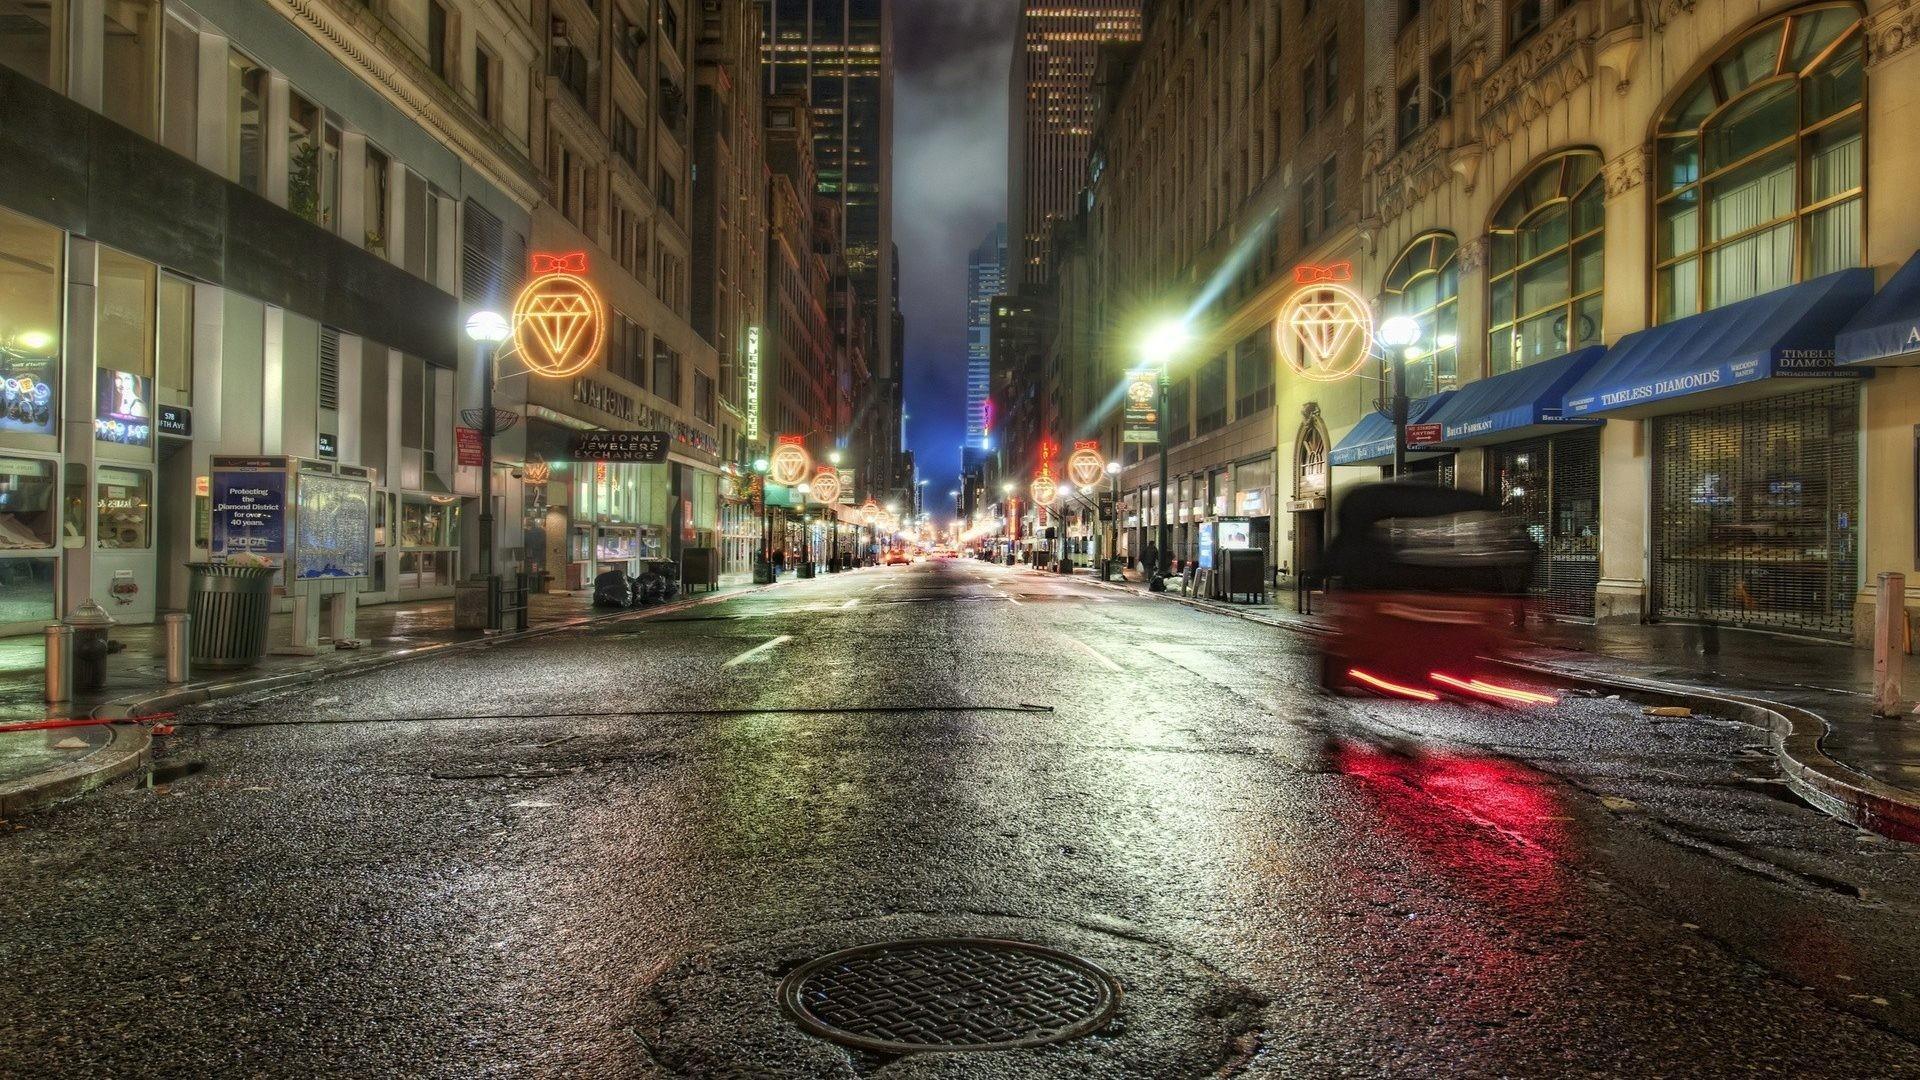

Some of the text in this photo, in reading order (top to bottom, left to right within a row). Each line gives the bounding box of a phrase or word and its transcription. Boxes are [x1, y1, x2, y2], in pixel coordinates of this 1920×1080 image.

[1782, 349, 1835, 359] TIMELE
[1779, 358, 1835, 368] DIAMON
[1602, 370, 1720, 406] TIMELESS DIAMONDS
[172, 421, 185, 430] AVE
[580, 434, 661, 443] NATIONAL
[580, 443, 658, 451] JEWELERS
[574, 450, 655, 459] EXCHANGE
[229, 488, 268, 496] Protecting
